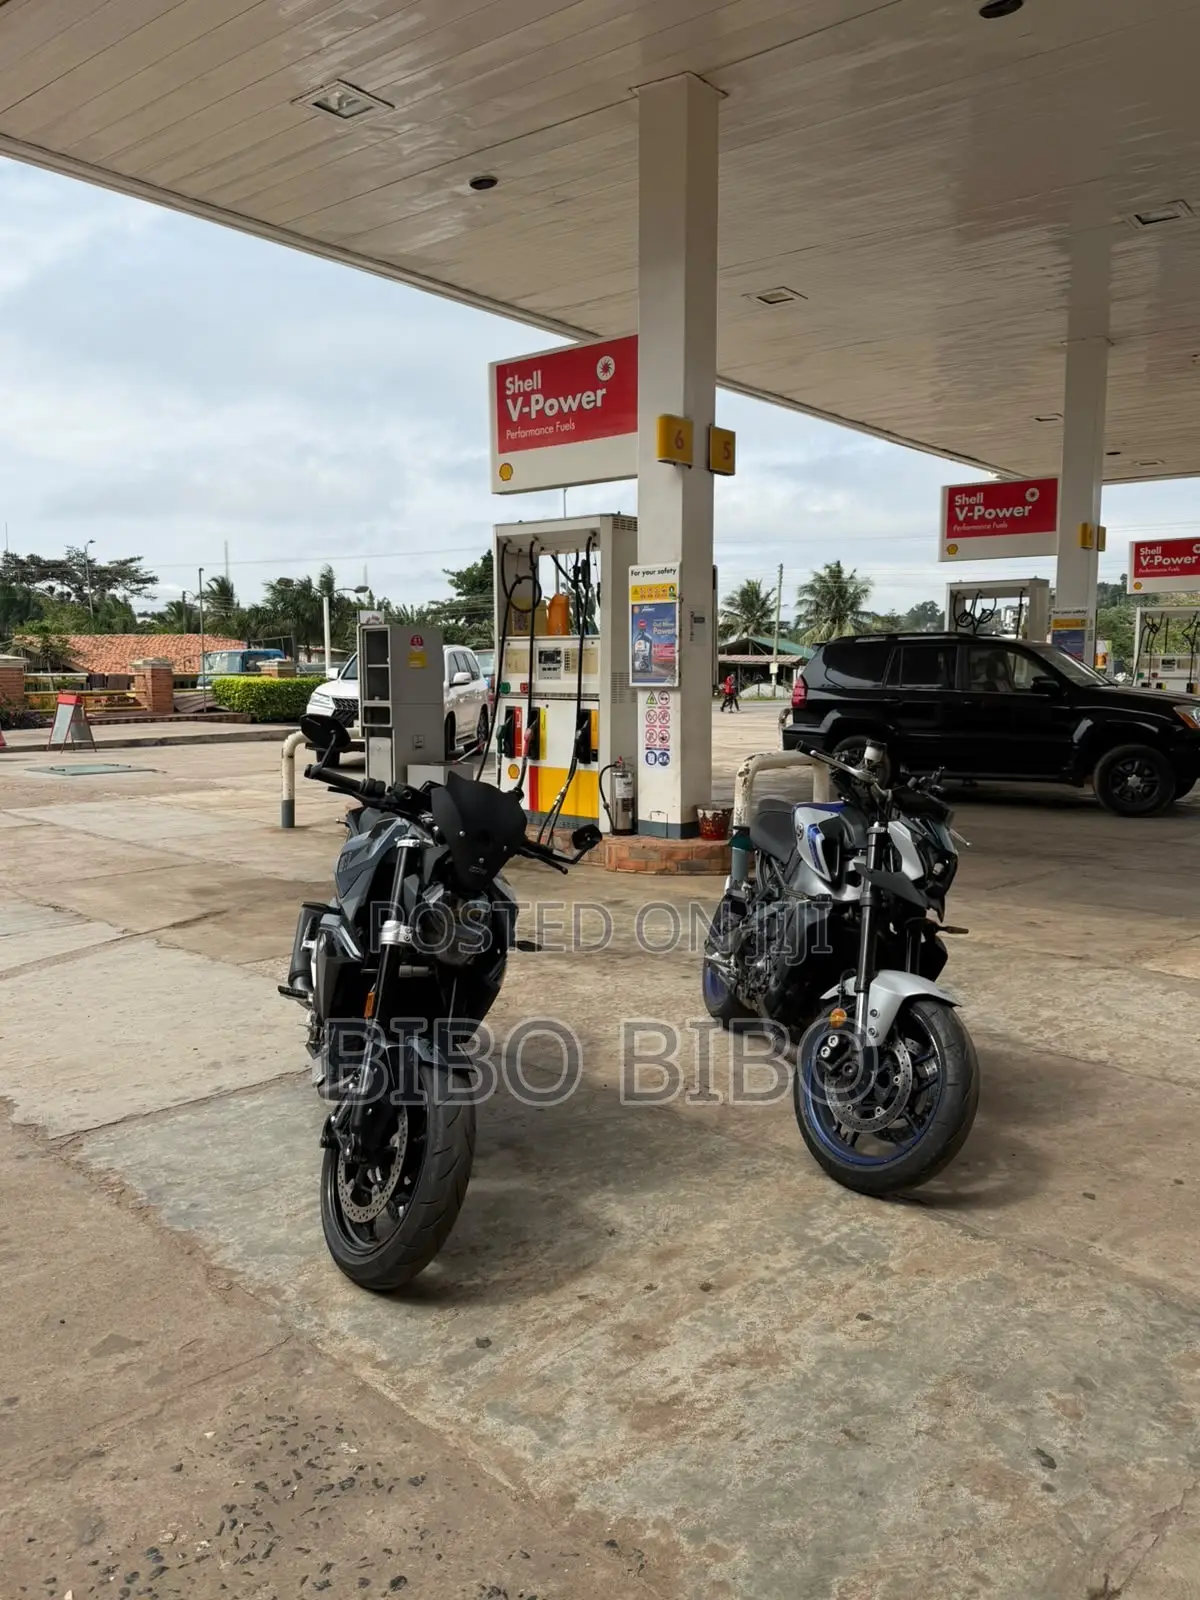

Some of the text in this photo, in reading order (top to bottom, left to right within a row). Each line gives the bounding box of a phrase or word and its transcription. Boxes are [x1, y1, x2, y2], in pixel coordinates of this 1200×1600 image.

[505, 370, 541, 395] Shell
[507, 388, 606, 422] V-Power
[506, 418, 575, 440] Performance Fuels
[674, 430, 685, 450] 6
[722, 441, 731, 460] 5
[955, 492, 984, 506] Shell
[955, 505, 1032, 521] V-Power
[1140, 546, 1162, 555] Shell
[1140, 555, 1199, 567] V-Power
[657, 567, 676, 575] safety
